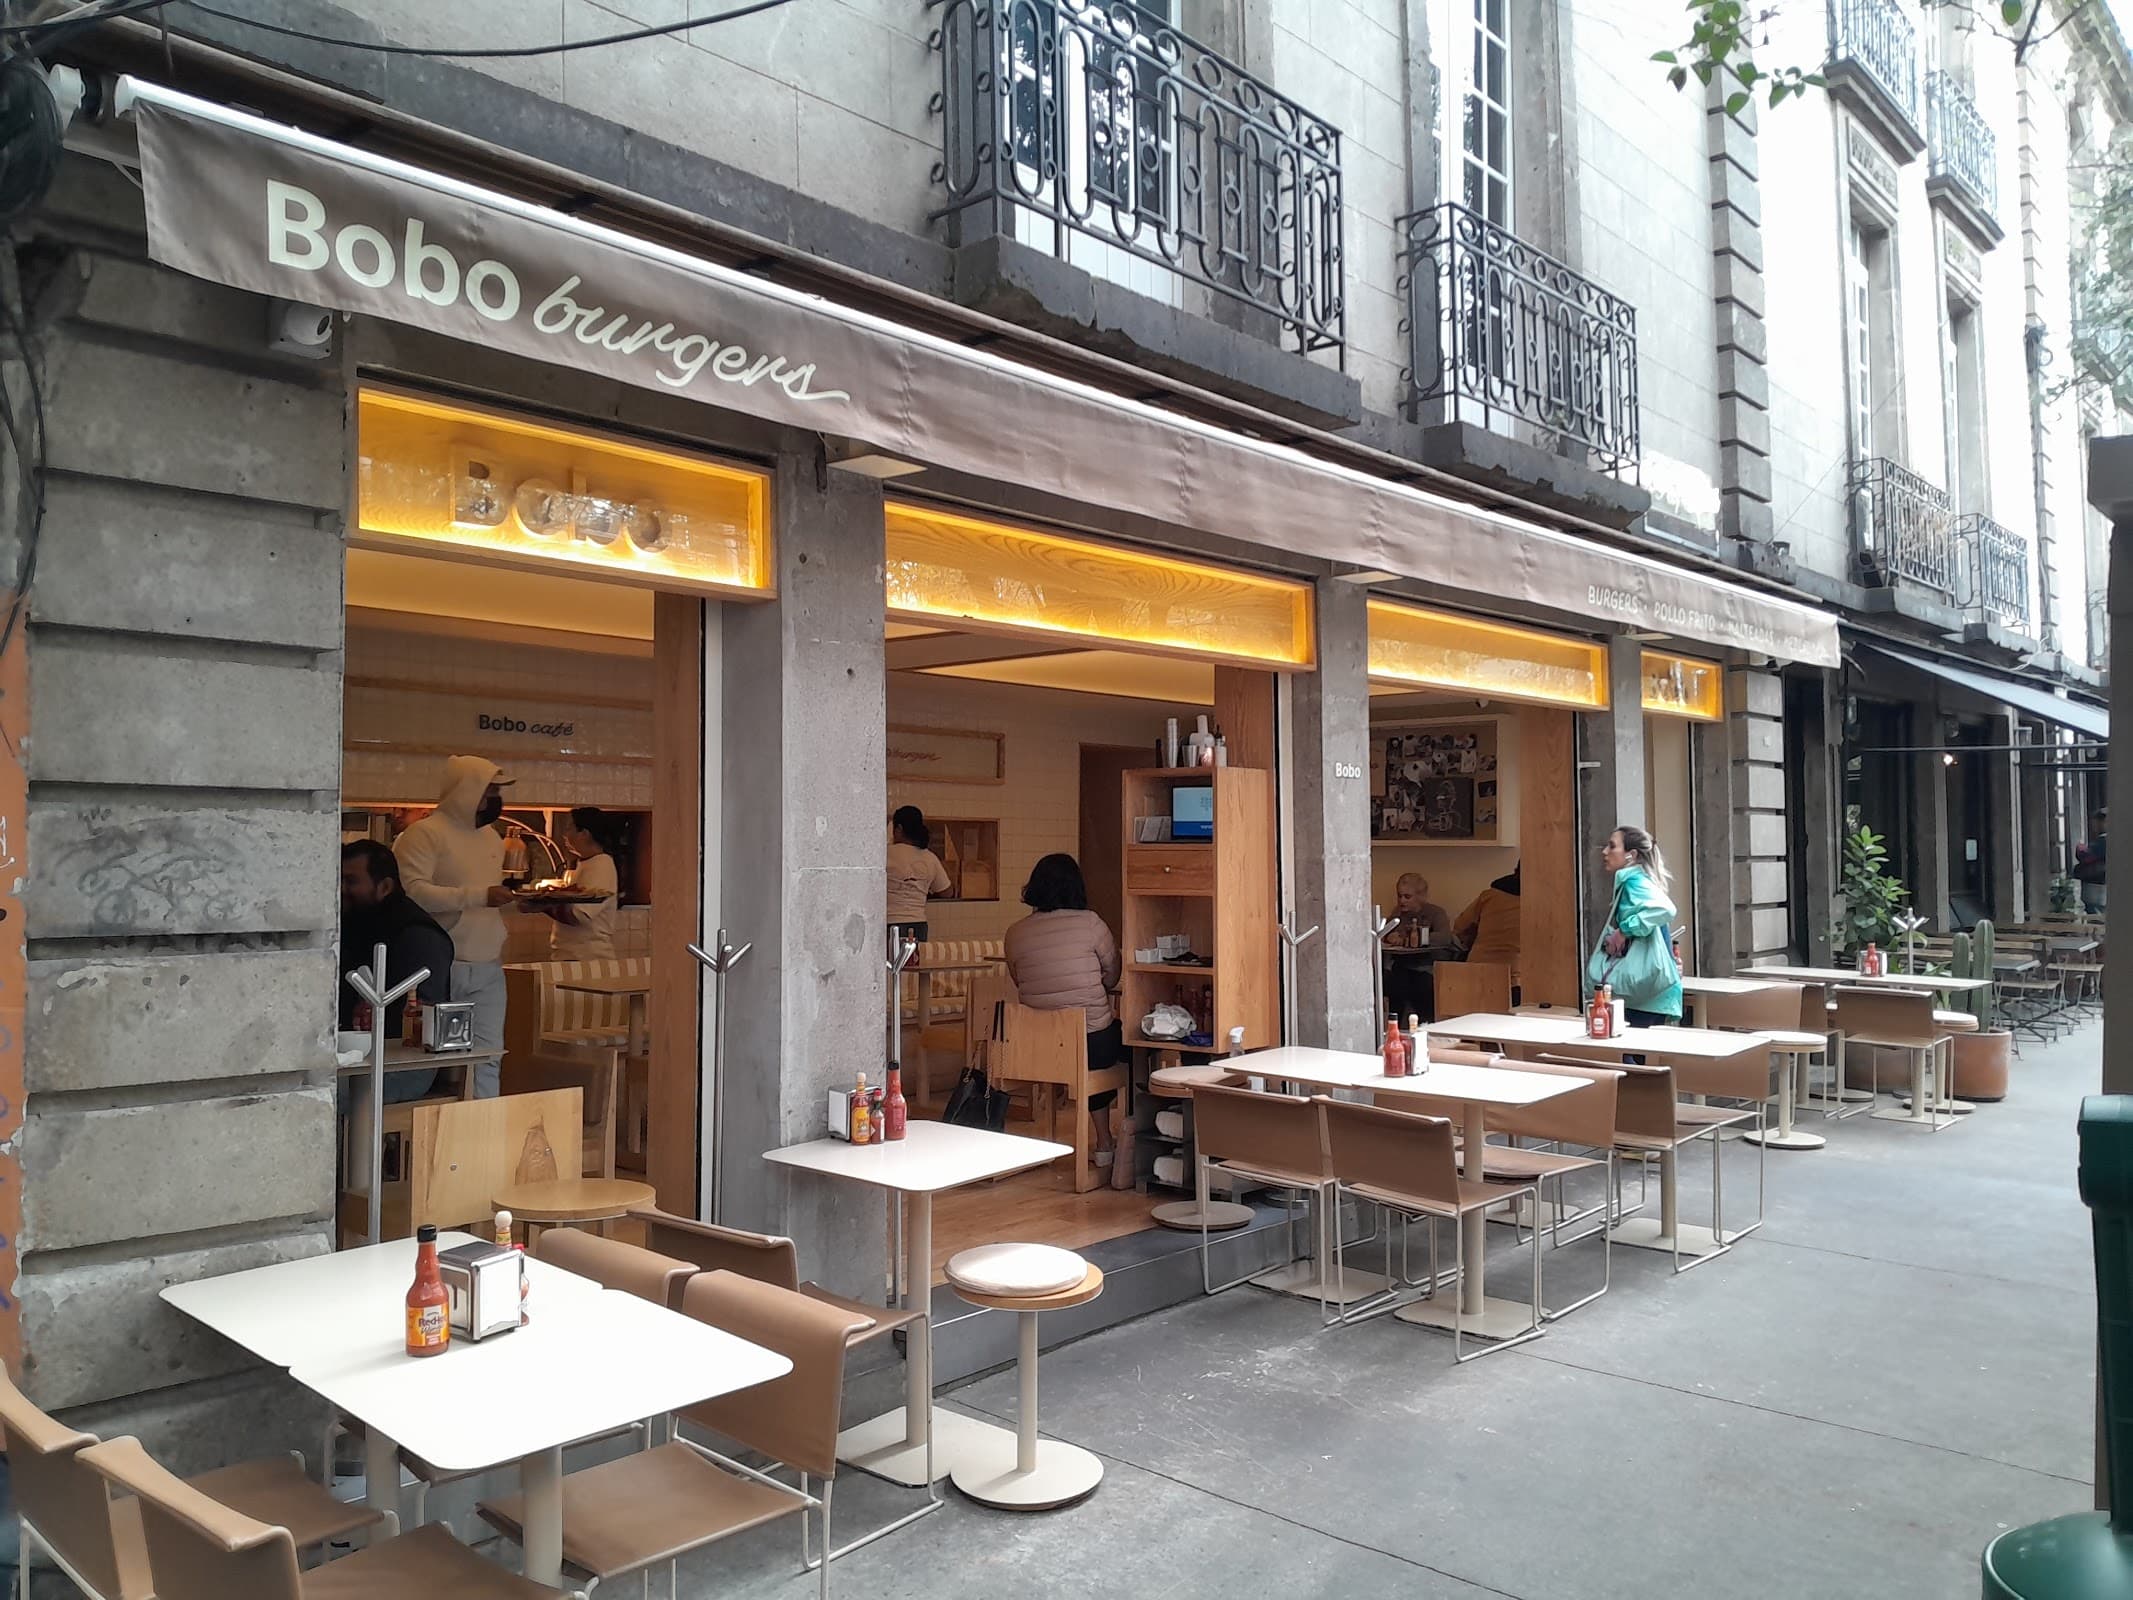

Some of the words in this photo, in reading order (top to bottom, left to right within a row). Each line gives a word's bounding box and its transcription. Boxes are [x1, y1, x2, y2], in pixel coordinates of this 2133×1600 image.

[265, 178, 521, 322] Bobo
[533, 275, 850, 401] burgers
[449, 441, 675, 555] Bobo
[1587, 584, 1639, 615] BURGERS
[1654, 602, 1686, 625] POLLO
[1688, 609, 1716, 632] FRITO
[479, 714, 527, 733] Bobo
[530, 722, 575, 738] café
[1335, 762, 1361, 778] Bobo
